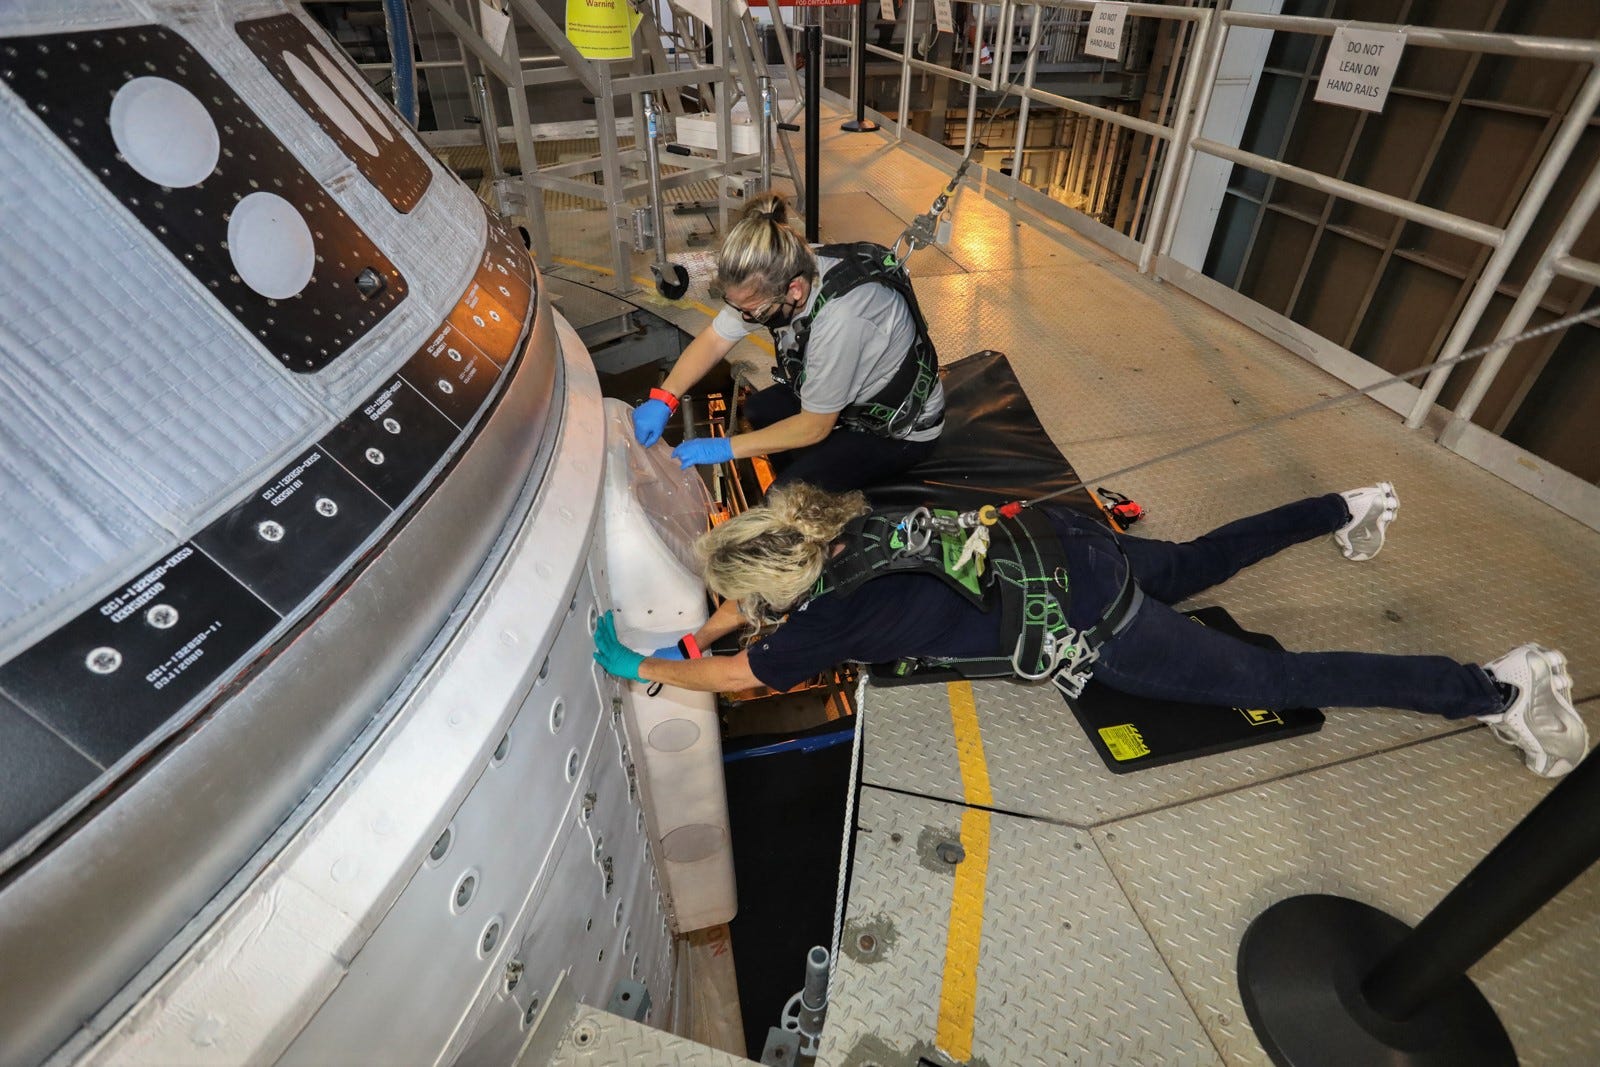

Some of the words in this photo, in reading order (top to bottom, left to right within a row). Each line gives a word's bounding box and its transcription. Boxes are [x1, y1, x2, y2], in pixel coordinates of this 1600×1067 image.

[585, 0, 615, 9] Warning
[1100, 12, 1107, 20] DO
[1107, 13, 1118, 21] NOT
[1095, 26, 1107, 34] LEAN
[1107, 27, 1114, 36] ON
[1090, 39, 1103, 47] HAND
[1103, 40, 1116, 50] RAILS
[1347, 41, 1362, 54] DO
[1362, 43, 1385, 57] NOT
[1339, 60, 1364, 74] LEAN
[1364, 64, 1380, 77] ON
[1326, 78, 1353, 93] HAND
[1353, 83, 1380, 98] RAILS
